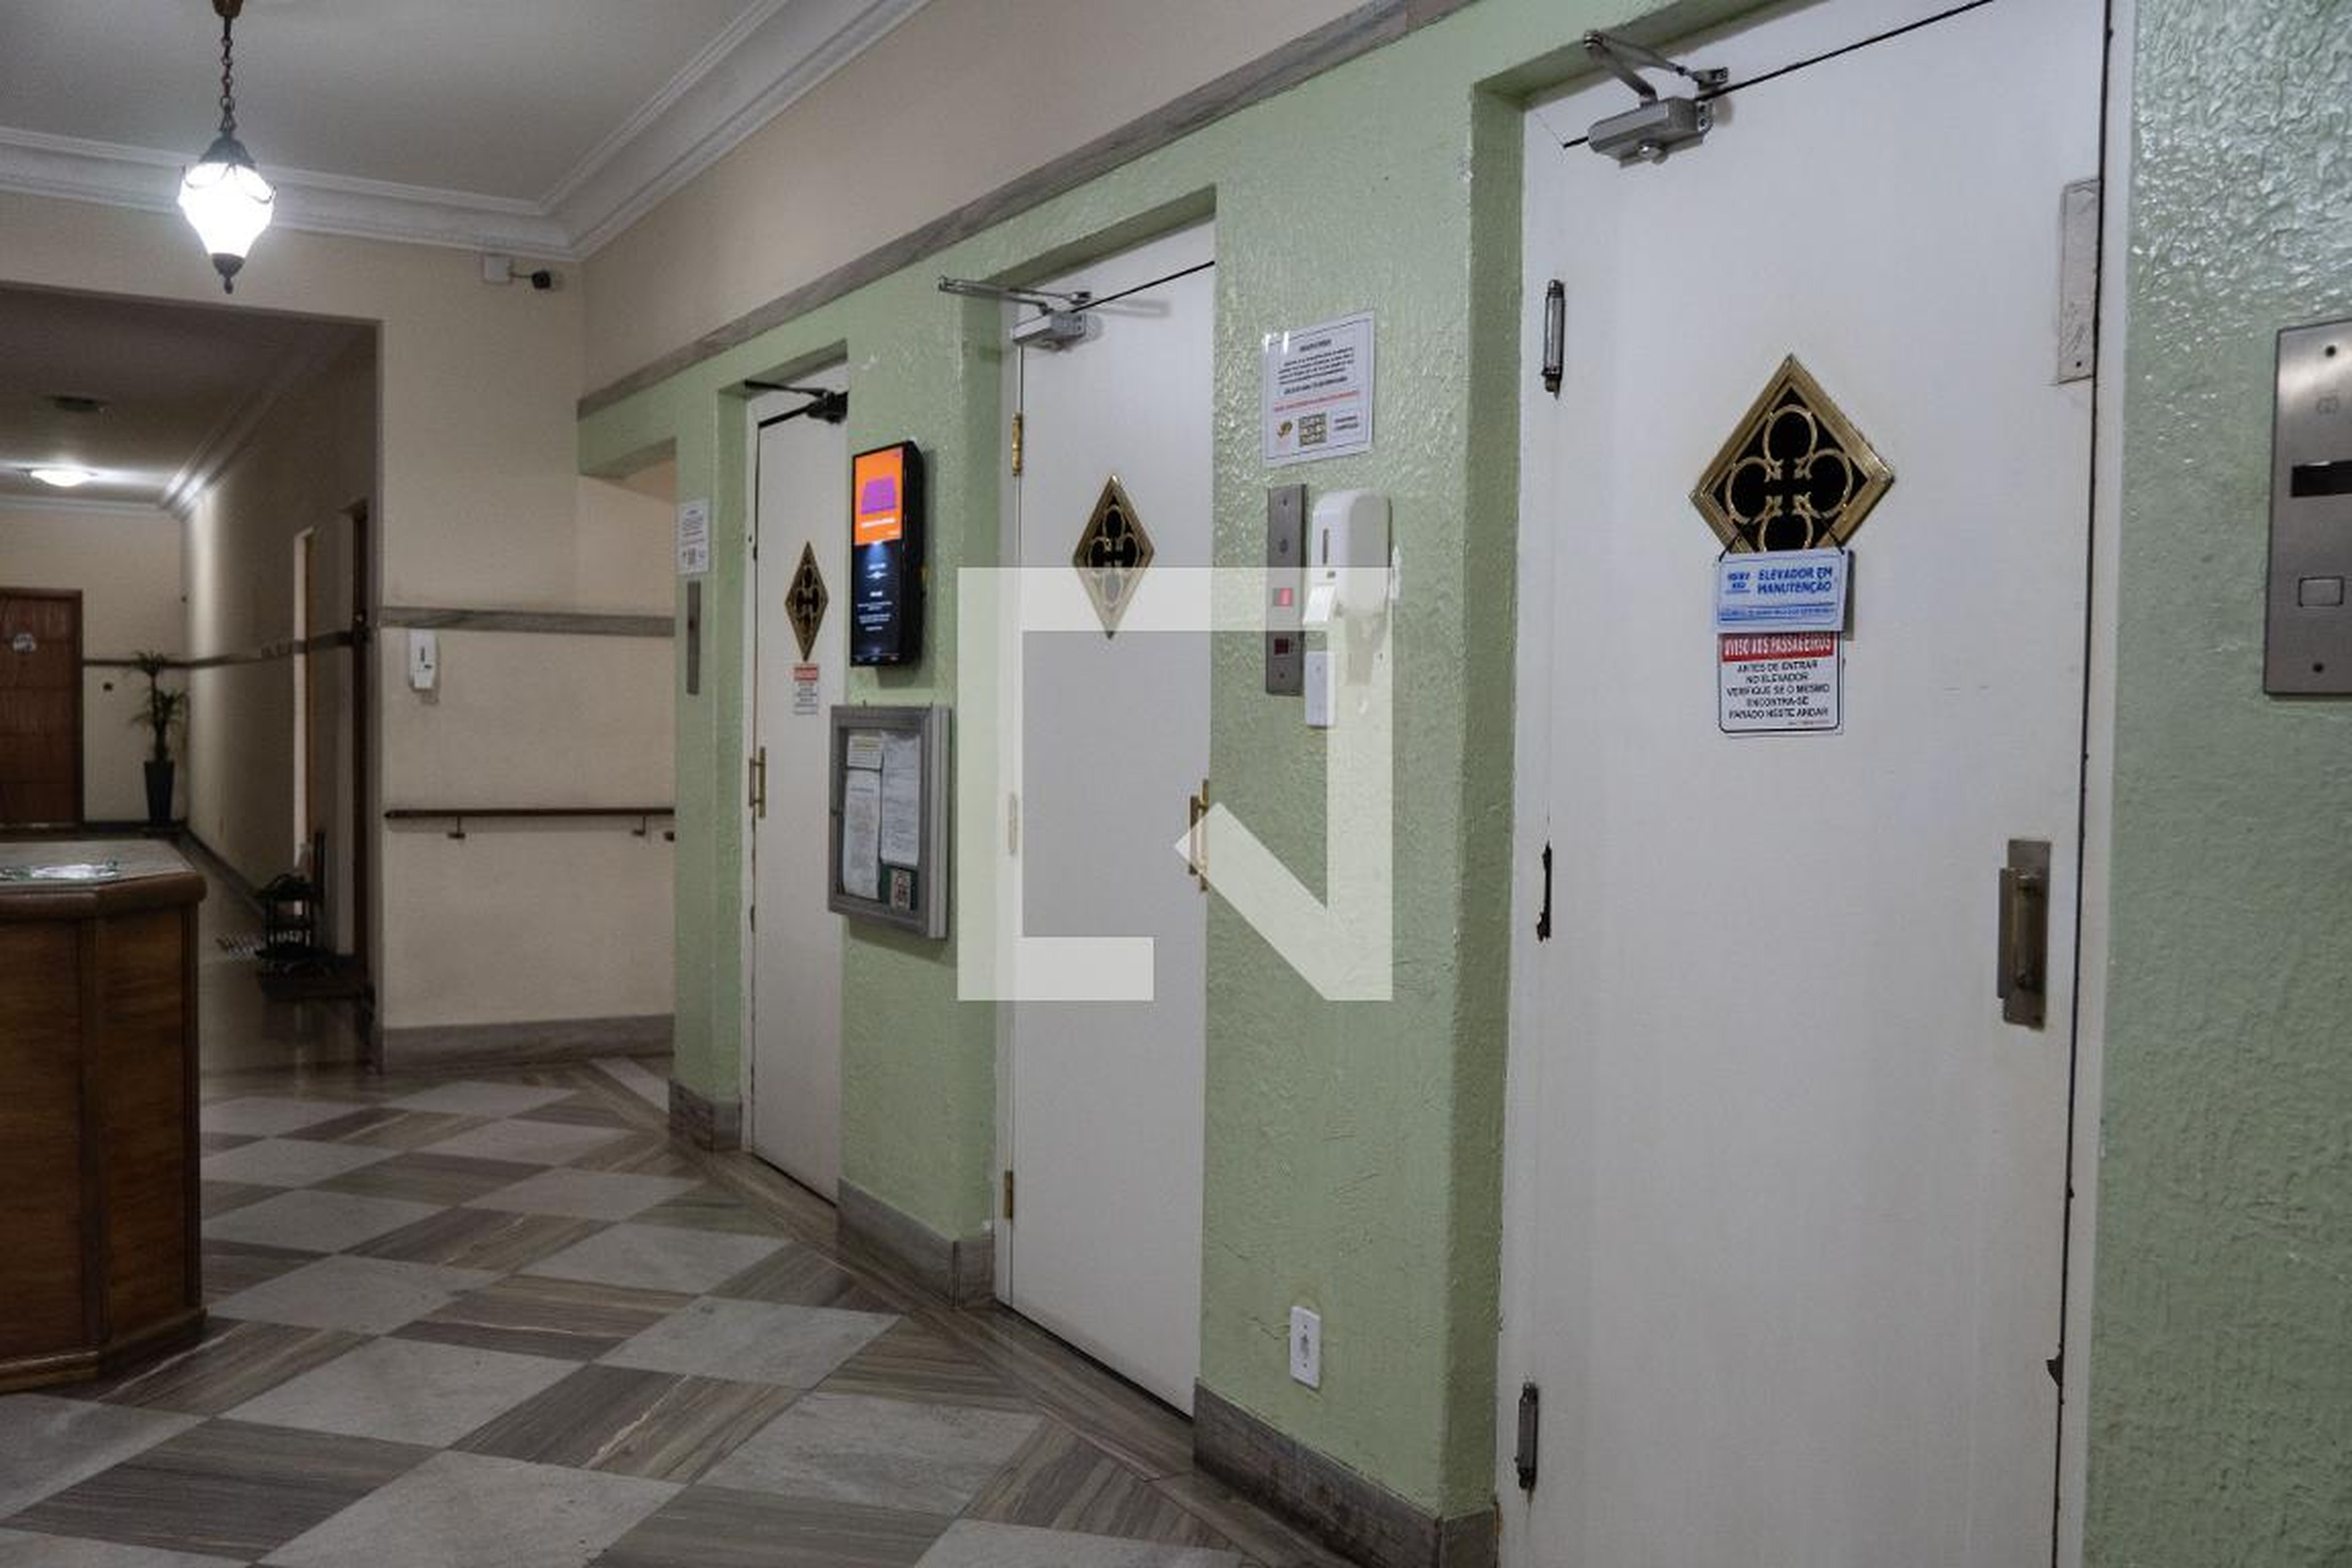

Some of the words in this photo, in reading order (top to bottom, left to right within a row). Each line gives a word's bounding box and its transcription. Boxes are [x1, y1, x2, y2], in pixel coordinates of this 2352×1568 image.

[1758, 567, 1814, 580] ELEVADOR
[1816, 566, 1833, 579] EM
[1757, 581, 1832, 594] MANUTENÇÃO
[1781, 660, 1818, 671] ENTRAR
[1787, 684, 1795, 694] O
